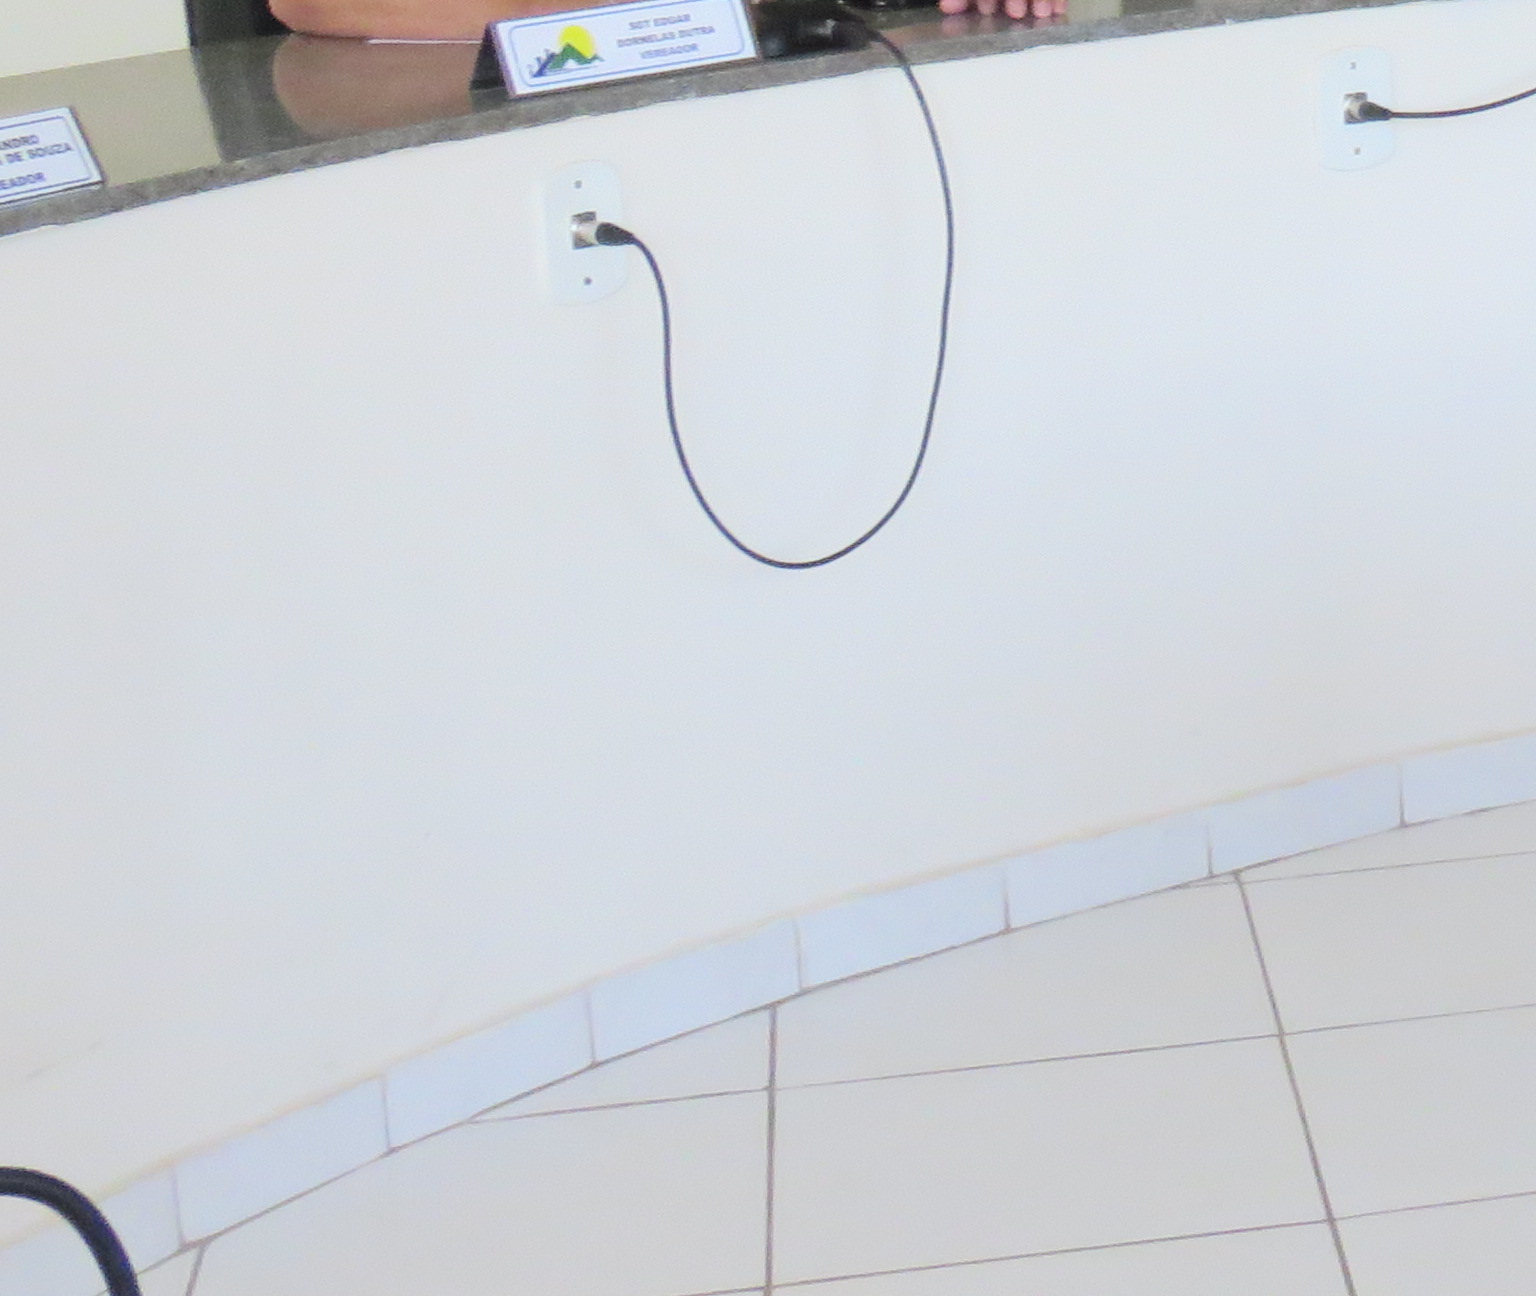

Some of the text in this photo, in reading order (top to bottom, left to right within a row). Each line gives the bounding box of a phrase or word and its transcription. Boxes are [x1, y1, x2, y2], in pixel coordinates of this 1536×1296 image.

[652, 13, 692, 27] EDGAR
[616, 25, 716, 48] DORNELAS DUTRA
[639, 42, 699, 60] VEREADOR
[5, 142, 73, 164] DE SOUZA
